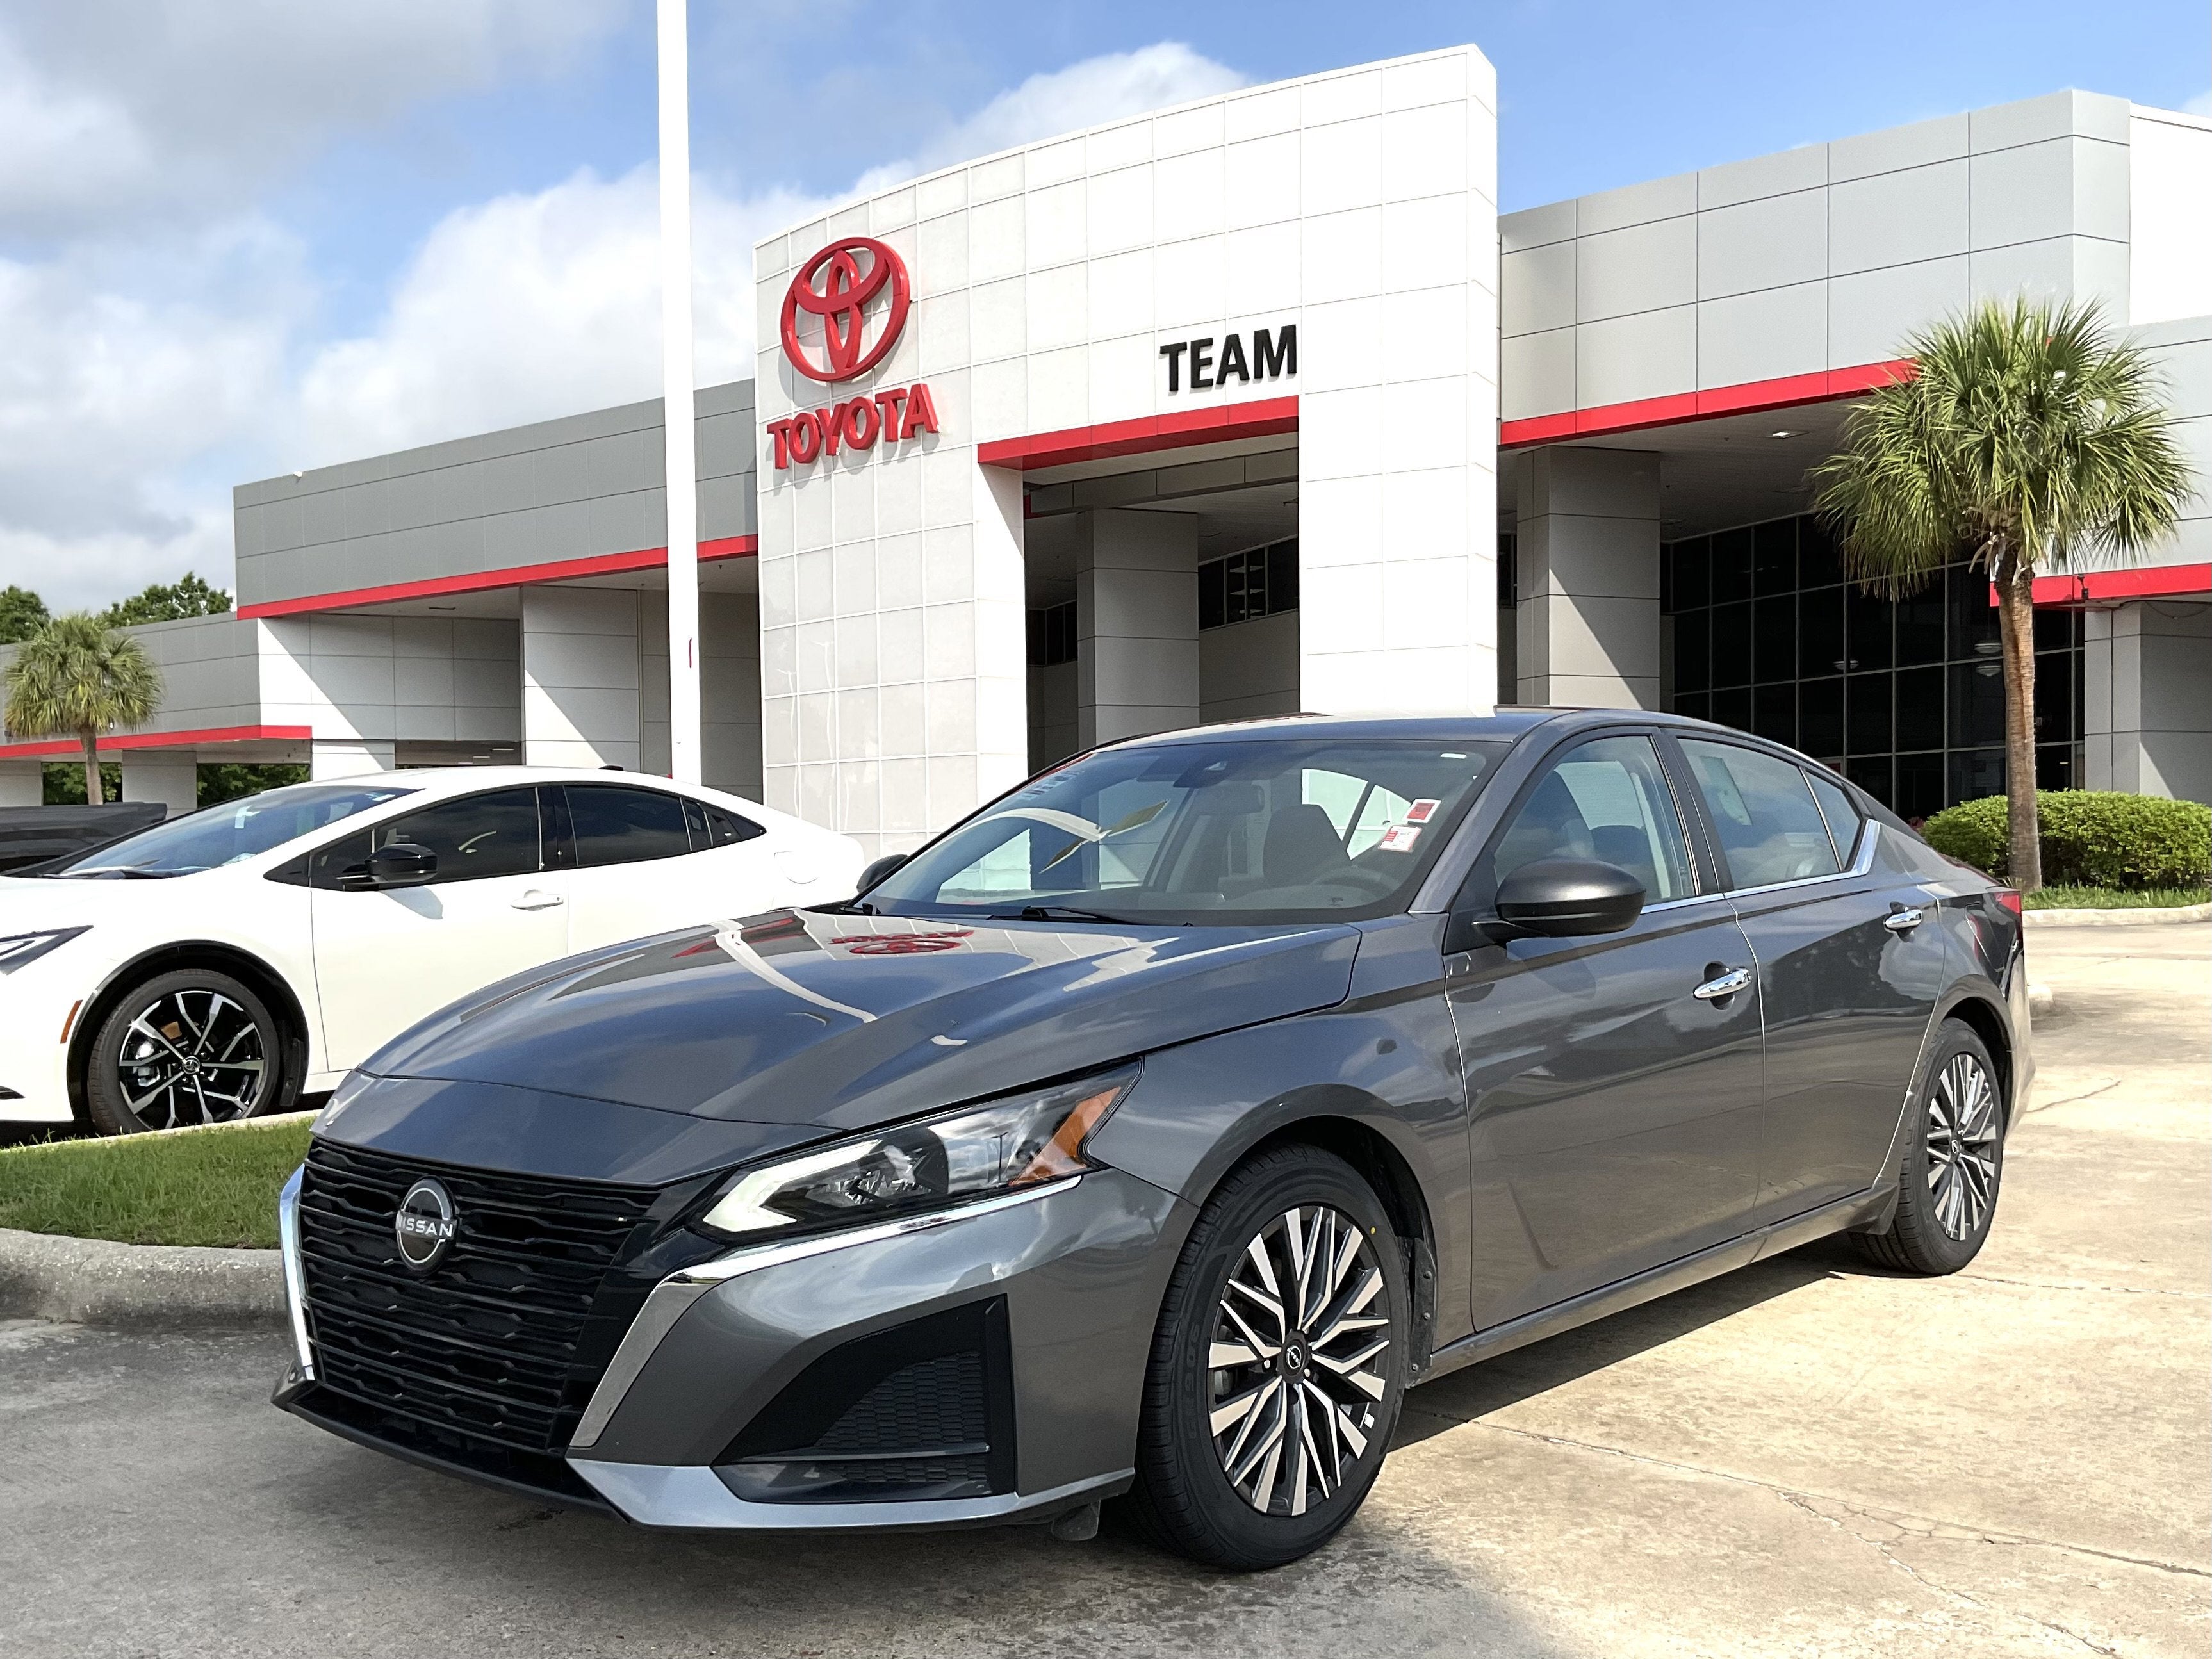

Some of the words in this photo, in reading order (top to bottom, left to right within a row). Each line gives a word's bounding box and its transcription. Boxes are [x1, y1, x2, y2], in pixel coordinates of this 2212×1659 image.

[1160, 324, 1297, 391] TEAM
[767, 383, 940, 469] TOYOTA
[396, 1214, 453, 1237] NISSAN
